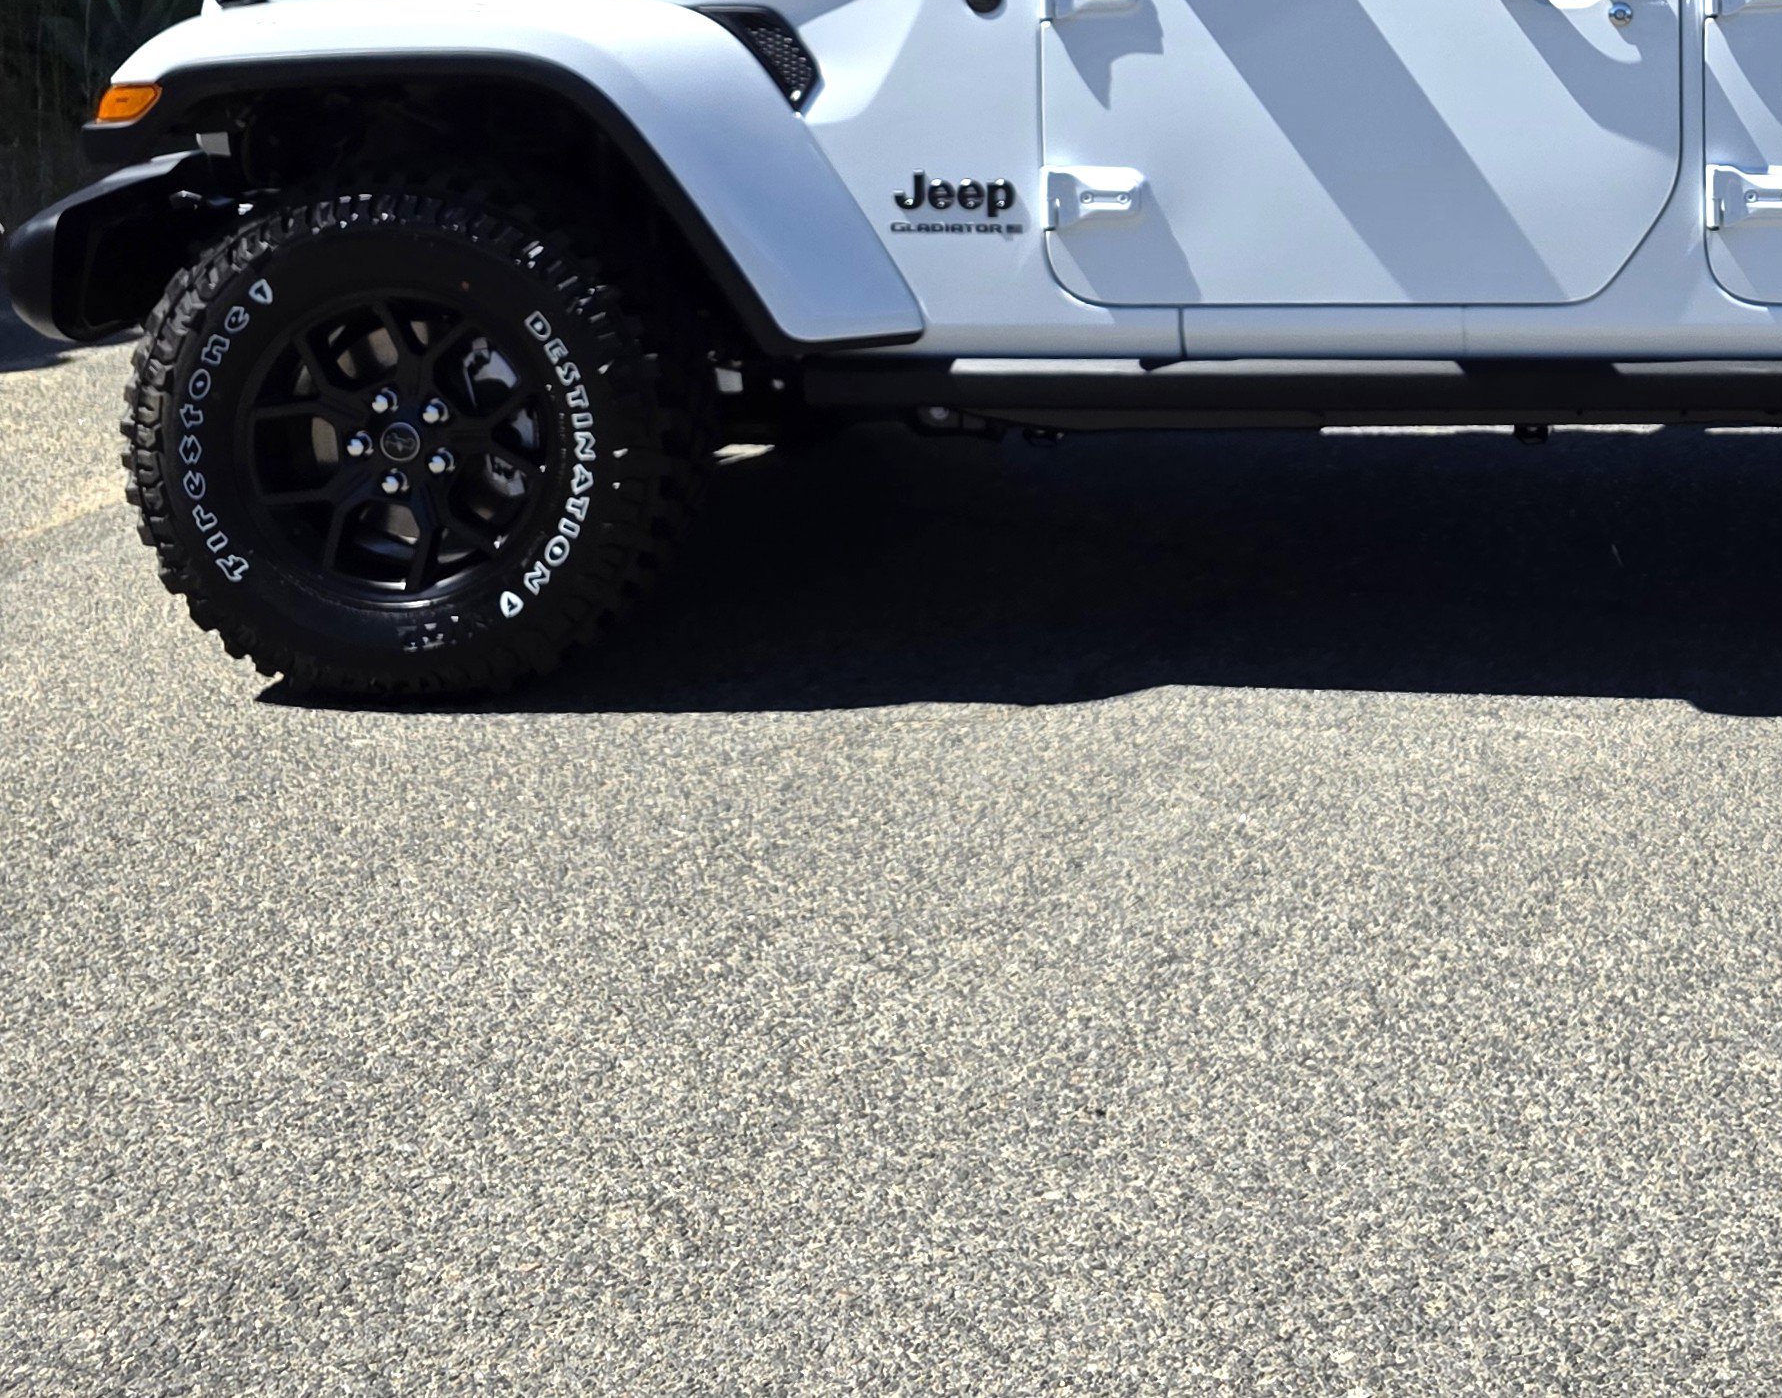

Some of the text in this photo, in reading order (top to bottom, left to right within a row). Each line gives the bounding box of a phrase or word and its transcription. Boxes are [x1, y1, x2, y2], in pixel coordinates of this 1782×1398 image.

[890, 221, 1003, 234] GLADIATOR
[893, 169, 1016, 218] Jeep
[179, 305, 249, 582] Firestone
[524, 310, 597, 596] DESTINATION
